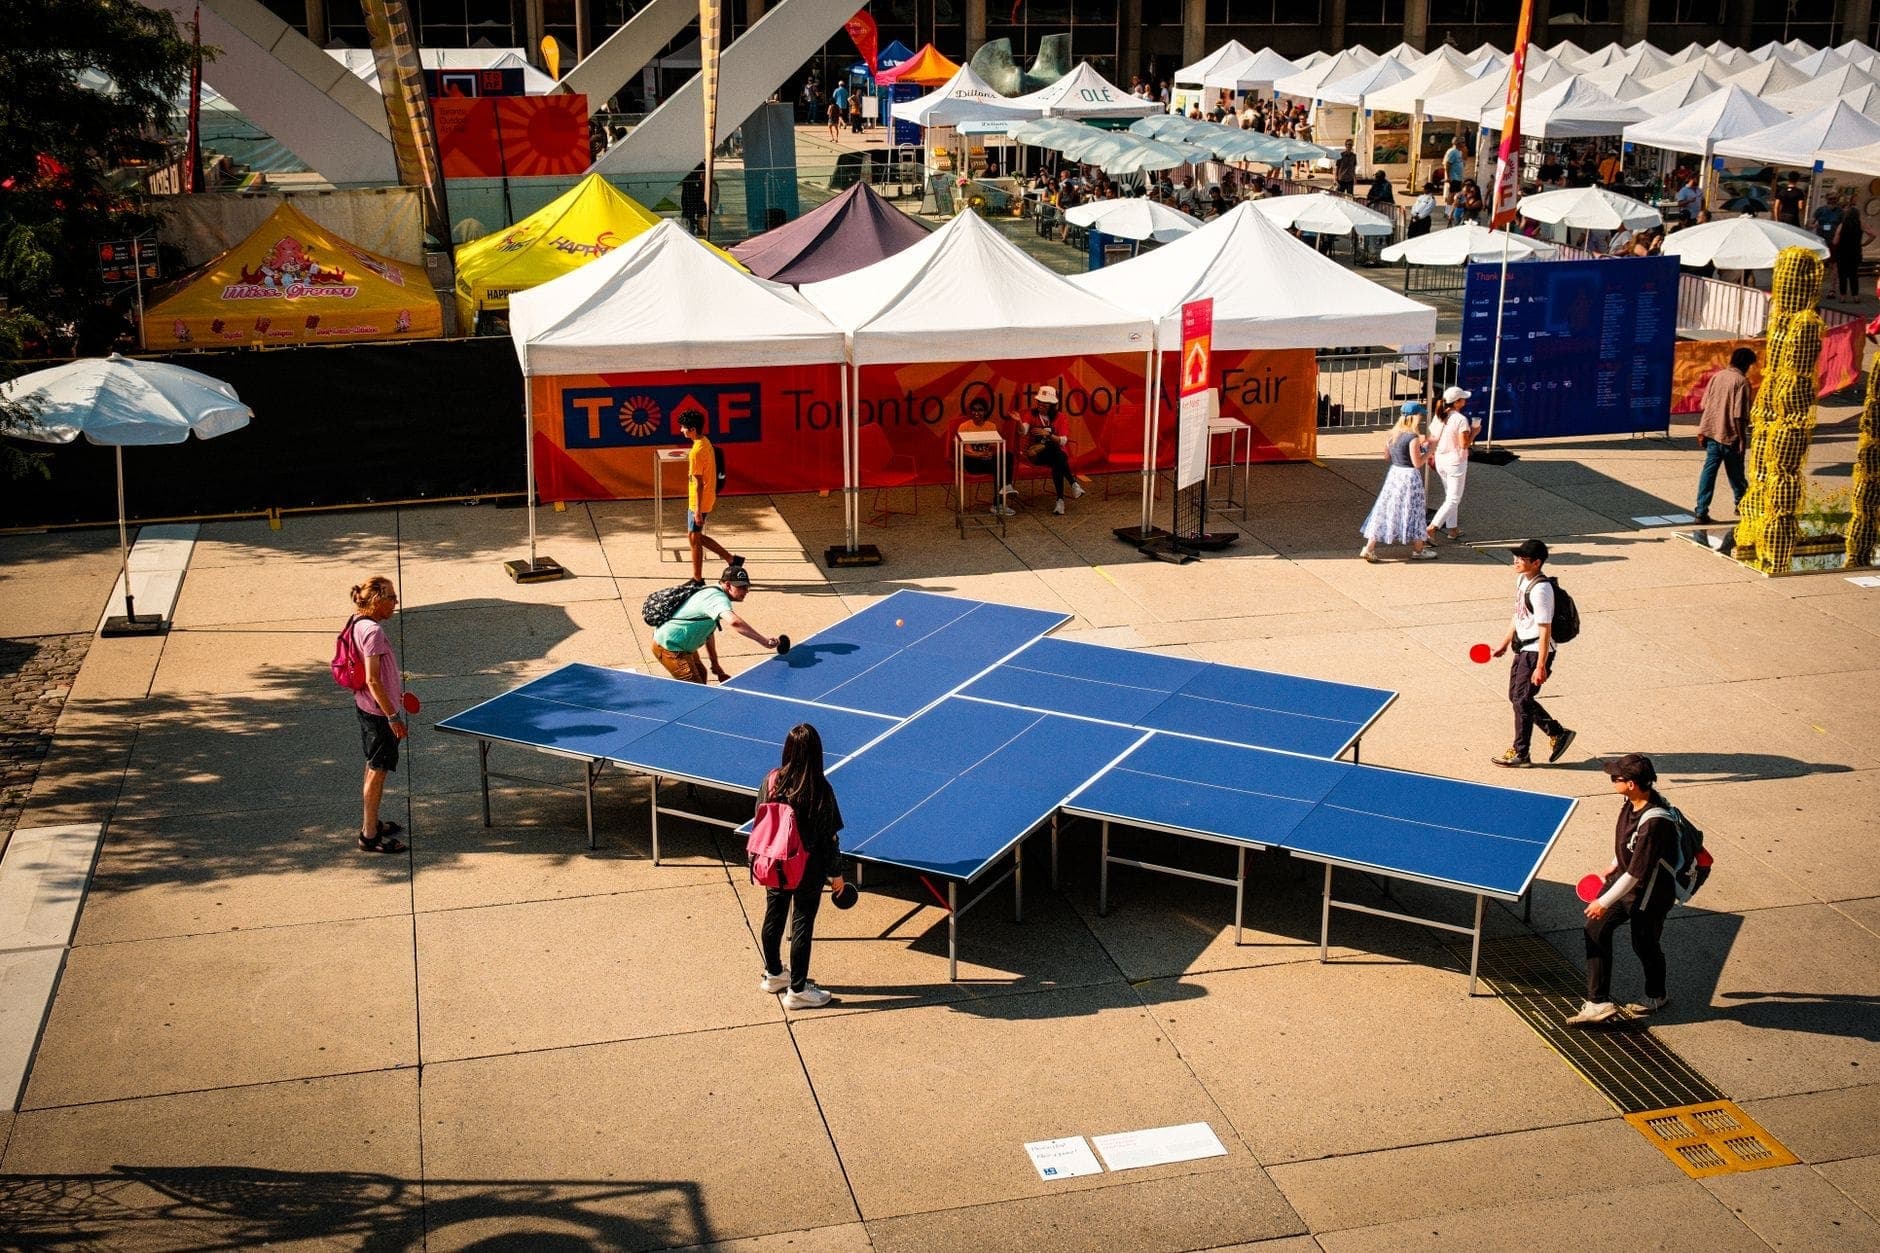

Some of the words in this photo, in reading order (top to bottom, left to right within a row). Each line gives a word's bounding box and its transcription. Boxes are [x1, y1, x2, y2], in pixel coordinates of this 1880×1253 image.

[1080, 86, 1115, 103] OLÉ
[286, 283, 358, 300] Greasy
[781, 388, 945, 431] Toronto
[1221, 366, 1288, 406] Fair
